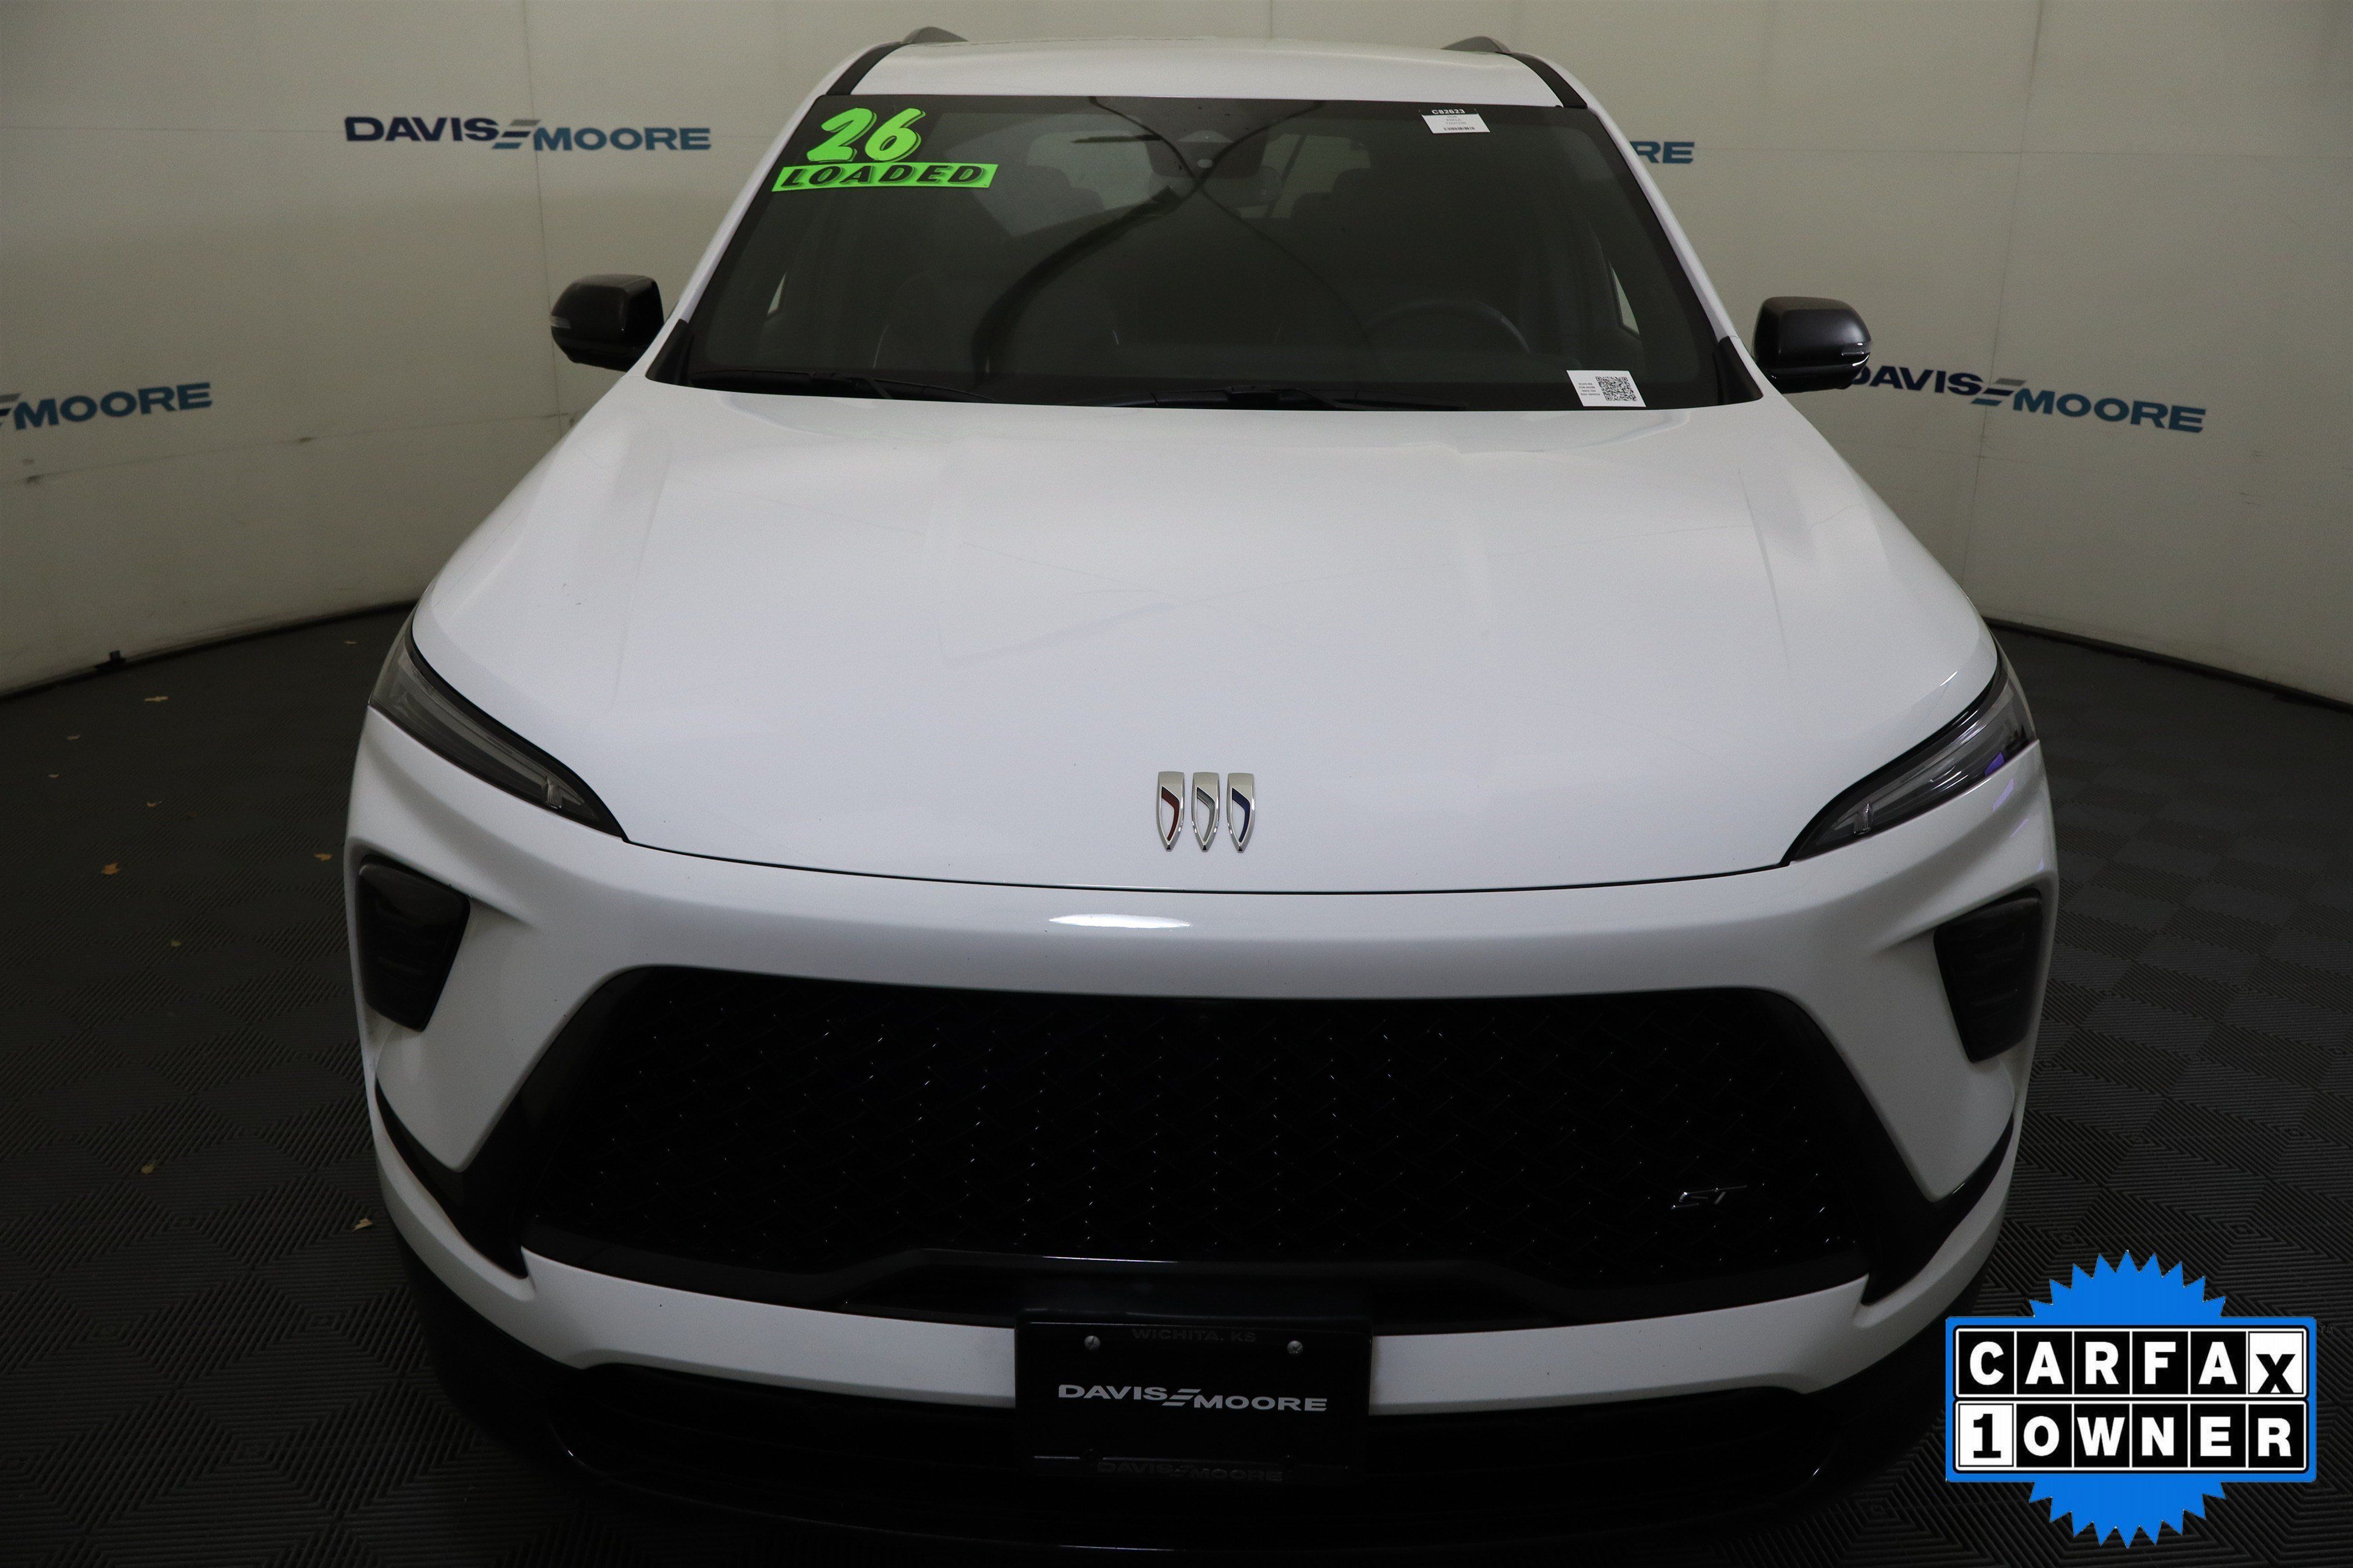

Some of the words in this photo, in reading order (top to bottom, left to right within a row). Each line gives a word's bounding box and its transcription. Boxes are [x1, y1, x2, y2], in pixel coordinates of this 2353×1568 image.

[344, 116, 499, 142] DAVIS
[533, 127, 711, 151] MOORE
[807, 107, 926, 162] 26
[780, 164, 985, 188] LOADED
[13, 382, 213, 430] MOORE
[2013, 388, 2206, 434] MOORE
[1230, 1331, 1257, 1342] KS
[1059, 1385, 1167, 1400] DAVIS
[1194, 1395, 1327, 1411] MOORE
[1097, 1462, 1172, 1474] DAVIS
[1189, 1468, 1282, 1482] MOORE
